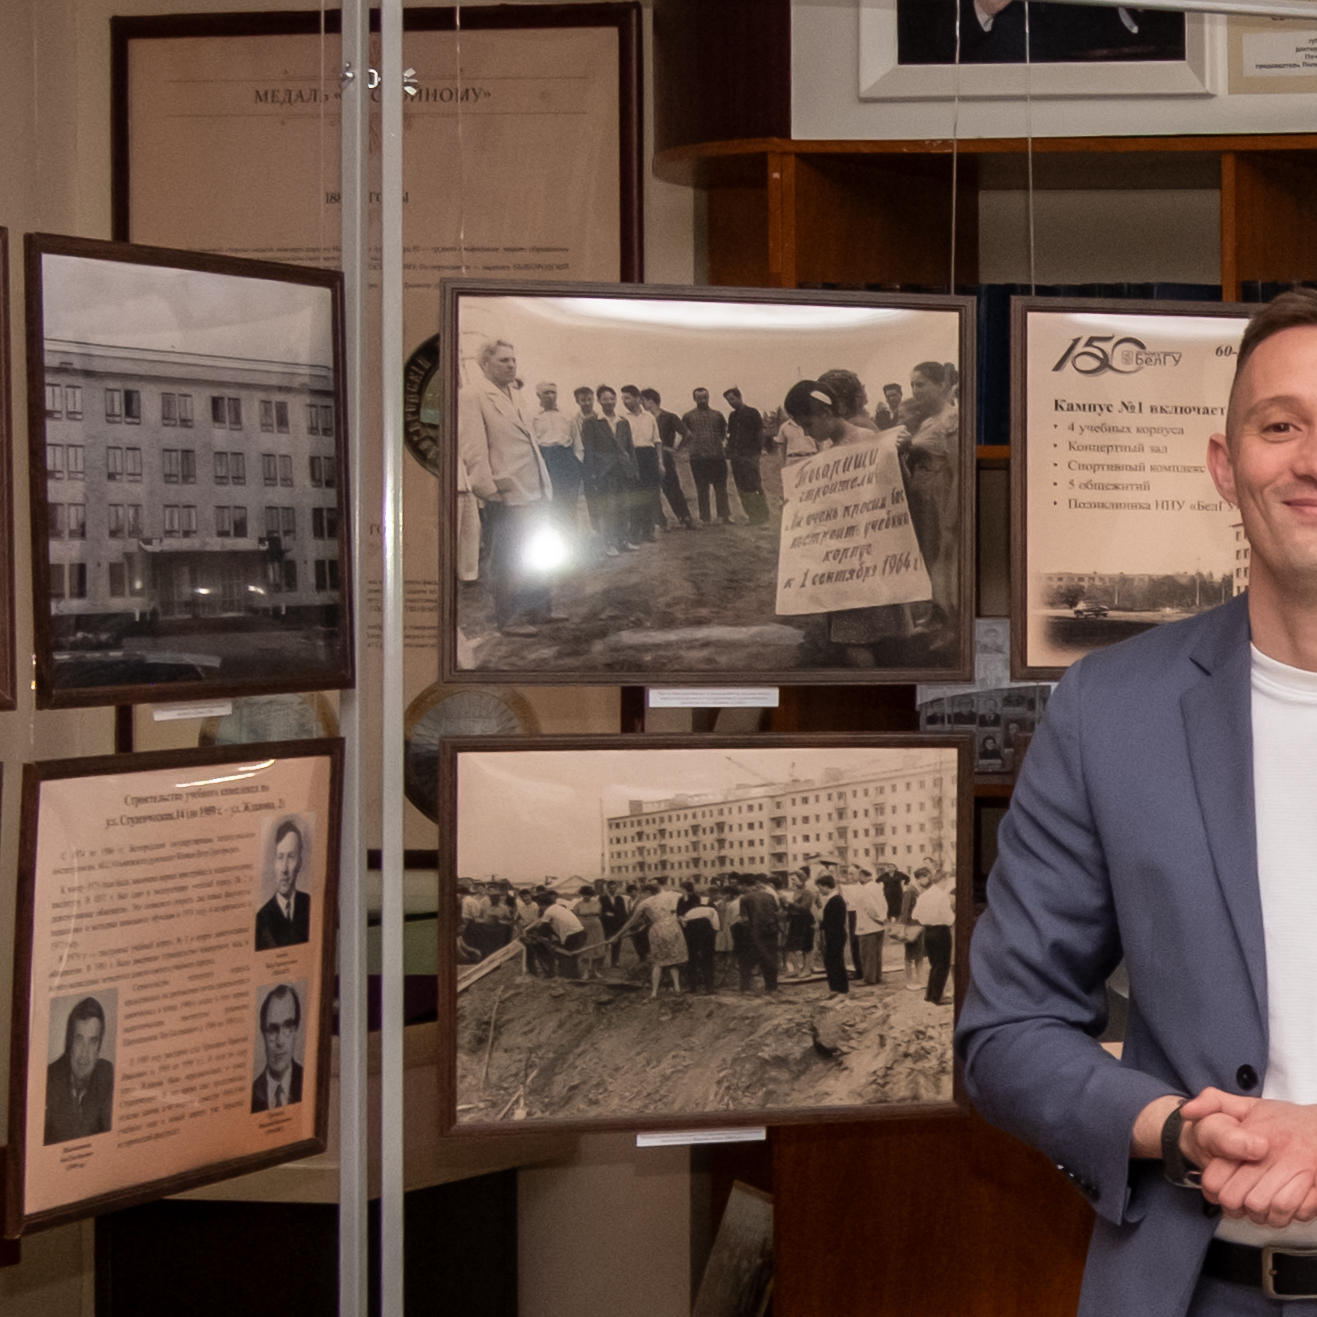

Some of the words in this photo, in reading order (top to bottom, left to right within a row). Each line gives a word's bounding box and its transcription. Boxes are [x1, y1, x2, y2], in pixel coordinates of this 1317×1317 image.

[254, 88, 329, 105] МЕДАЛЬ
[1053, 399, 1113, 416] Кампус
[1118, 401, 1143, 415] №1
[1150, 405, 1226, 416] включает
[1068, 424, 1075, 432] 4
[1079, 423, 1132, 435] учебных
[1136, 426, 1185, 435] корпуса
[1068, 441, 1145, 454] Концертный
[1068, 460, 1146, 473] Спортивный
[1150, 465, 1206, 473] комплекс
[1068, 479, 1075, 490] 5
[1079, 479, 1150, 491] общежитий
[1068, 499, 1151, 511] Поликлиника
[1155, 500, 1186, 511] НИУ
[822, 543, 873, 564] корпус
